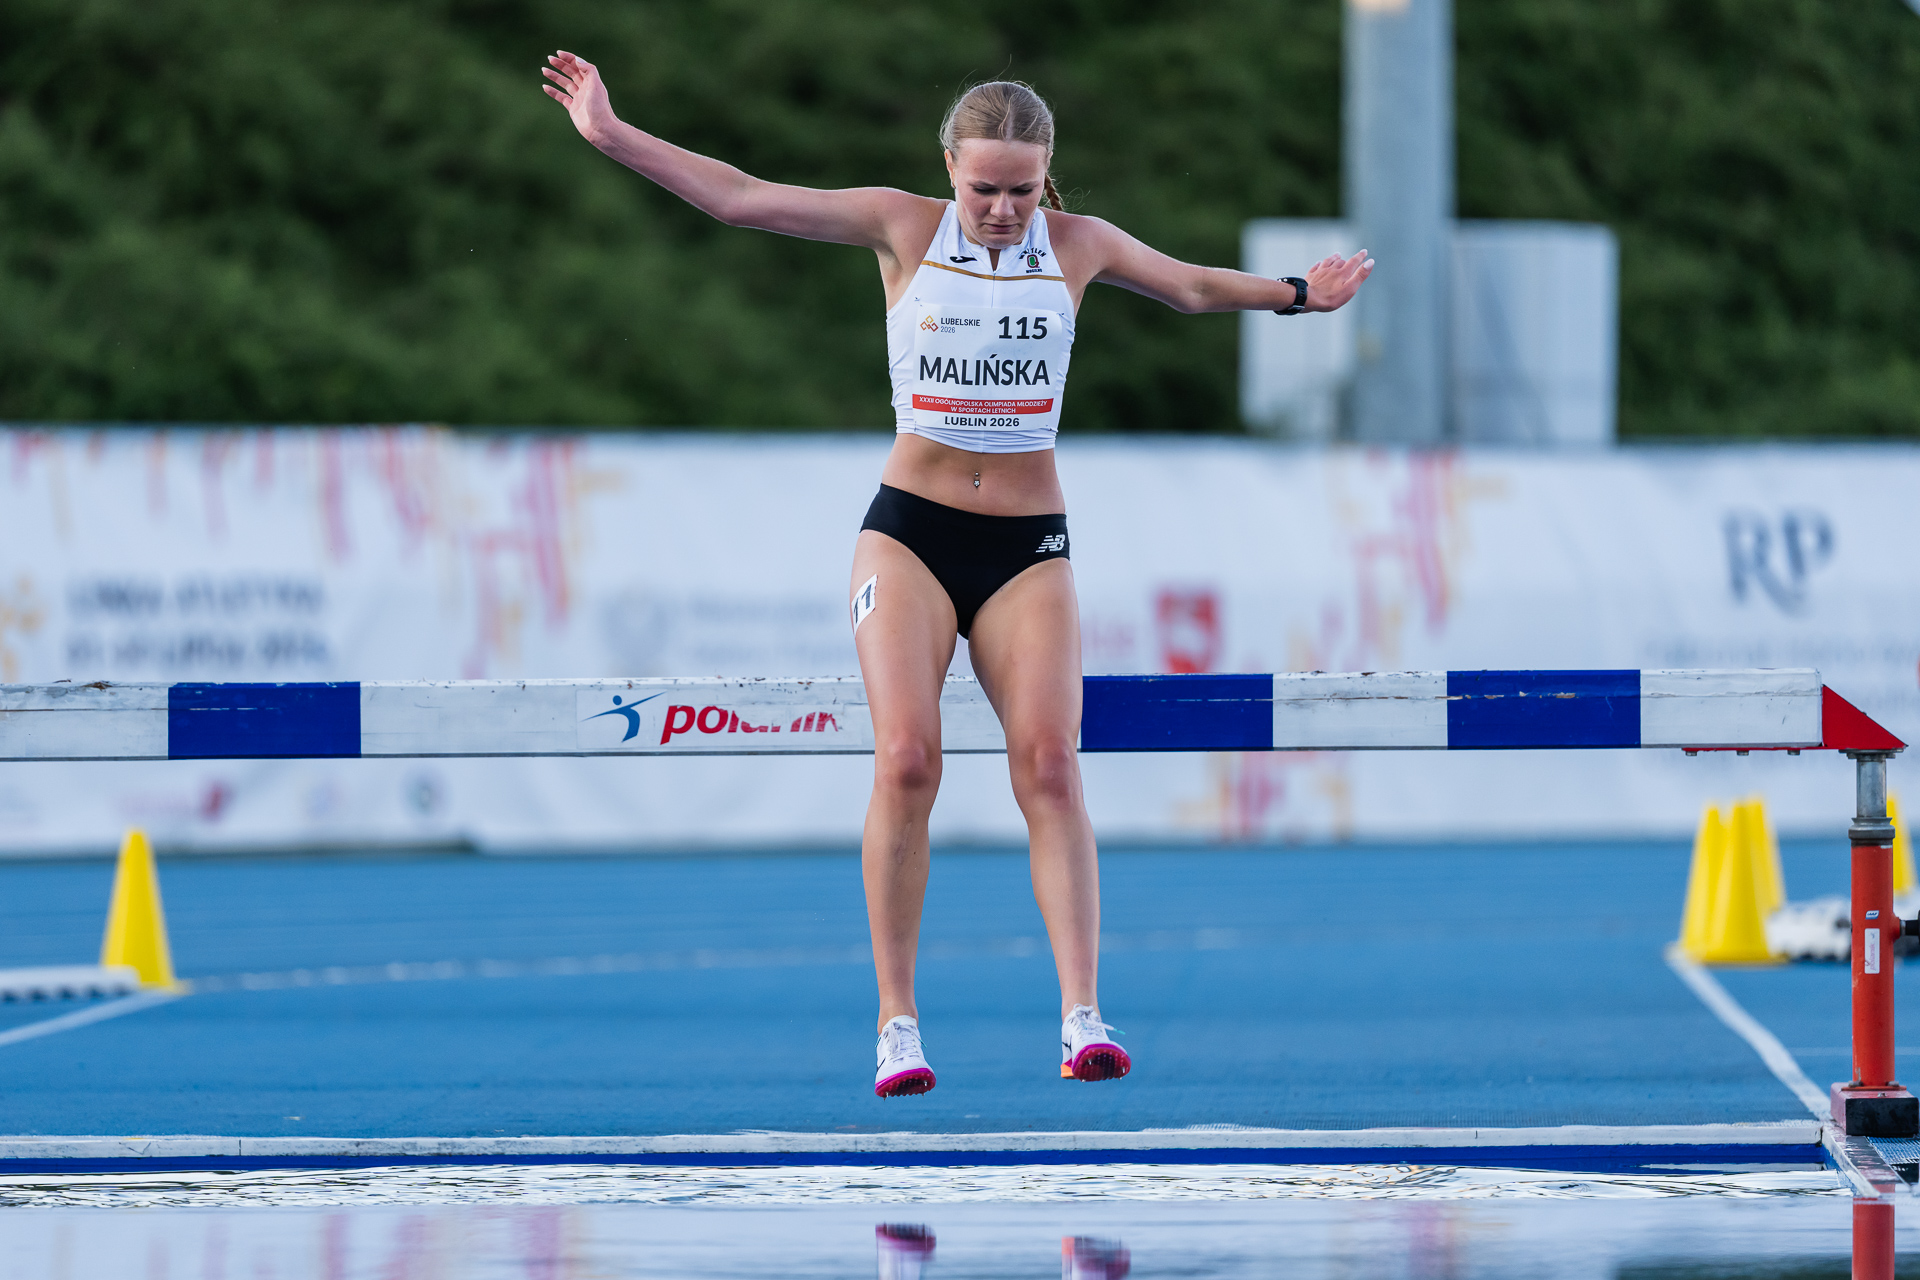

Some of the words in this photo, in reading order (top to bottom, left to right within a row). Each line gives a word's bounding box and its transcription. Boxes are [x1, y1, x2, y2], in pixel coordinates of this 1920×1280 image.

[940, 317, 981, 327] LUBELSKIE
[998, 316, 1048, 340] 115
[940, 325, 956, 334] 2026
[919, 353, 1050, 386] MALIŃSKA
[934, 398, 983, 407] OGÓLNOPOLSKA
[1016, 399, 1048, 407] MŁODZIEŻY
[944, 415, 987, 427] LUBLIN
[989, 417, 1020, 427] 2026
[1721, 507, 1837, 616] RP
